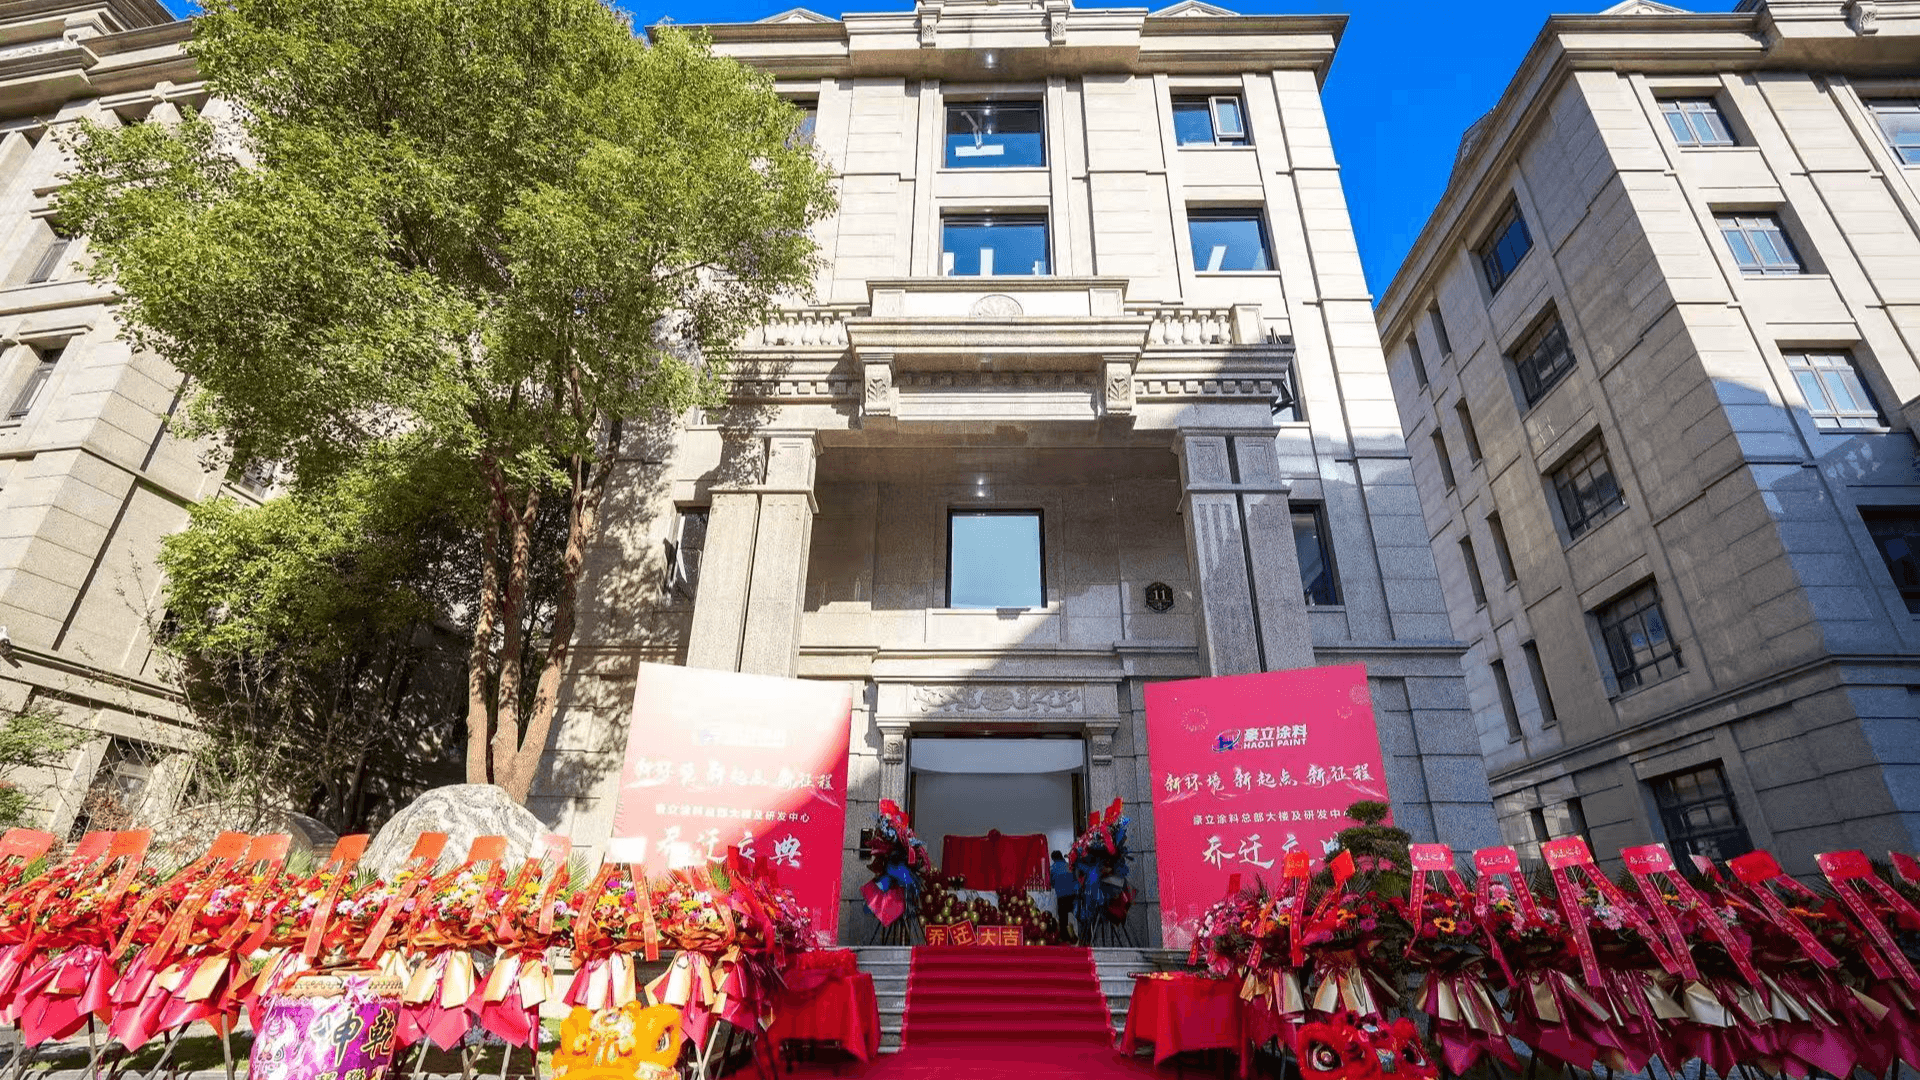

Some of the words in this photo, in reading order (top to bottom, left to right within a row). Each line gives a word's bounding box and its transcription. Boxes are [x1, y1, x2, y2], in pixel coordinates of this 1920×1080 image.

[1153, 589, 1166, 600] 11
[1244, 724, 1307, 742] 豪立涂料
[1243, 740, 1274, 750] HAOLI
[1277, 738, 1307, 747] PAINT
[1163, 770, 1225, 796] 新环境
[1232, 765, 1298, 791] 新起点
[1306, 762, 1375, 788] 新征程
[929, 925, 1019, 946] 乔迁大吉
